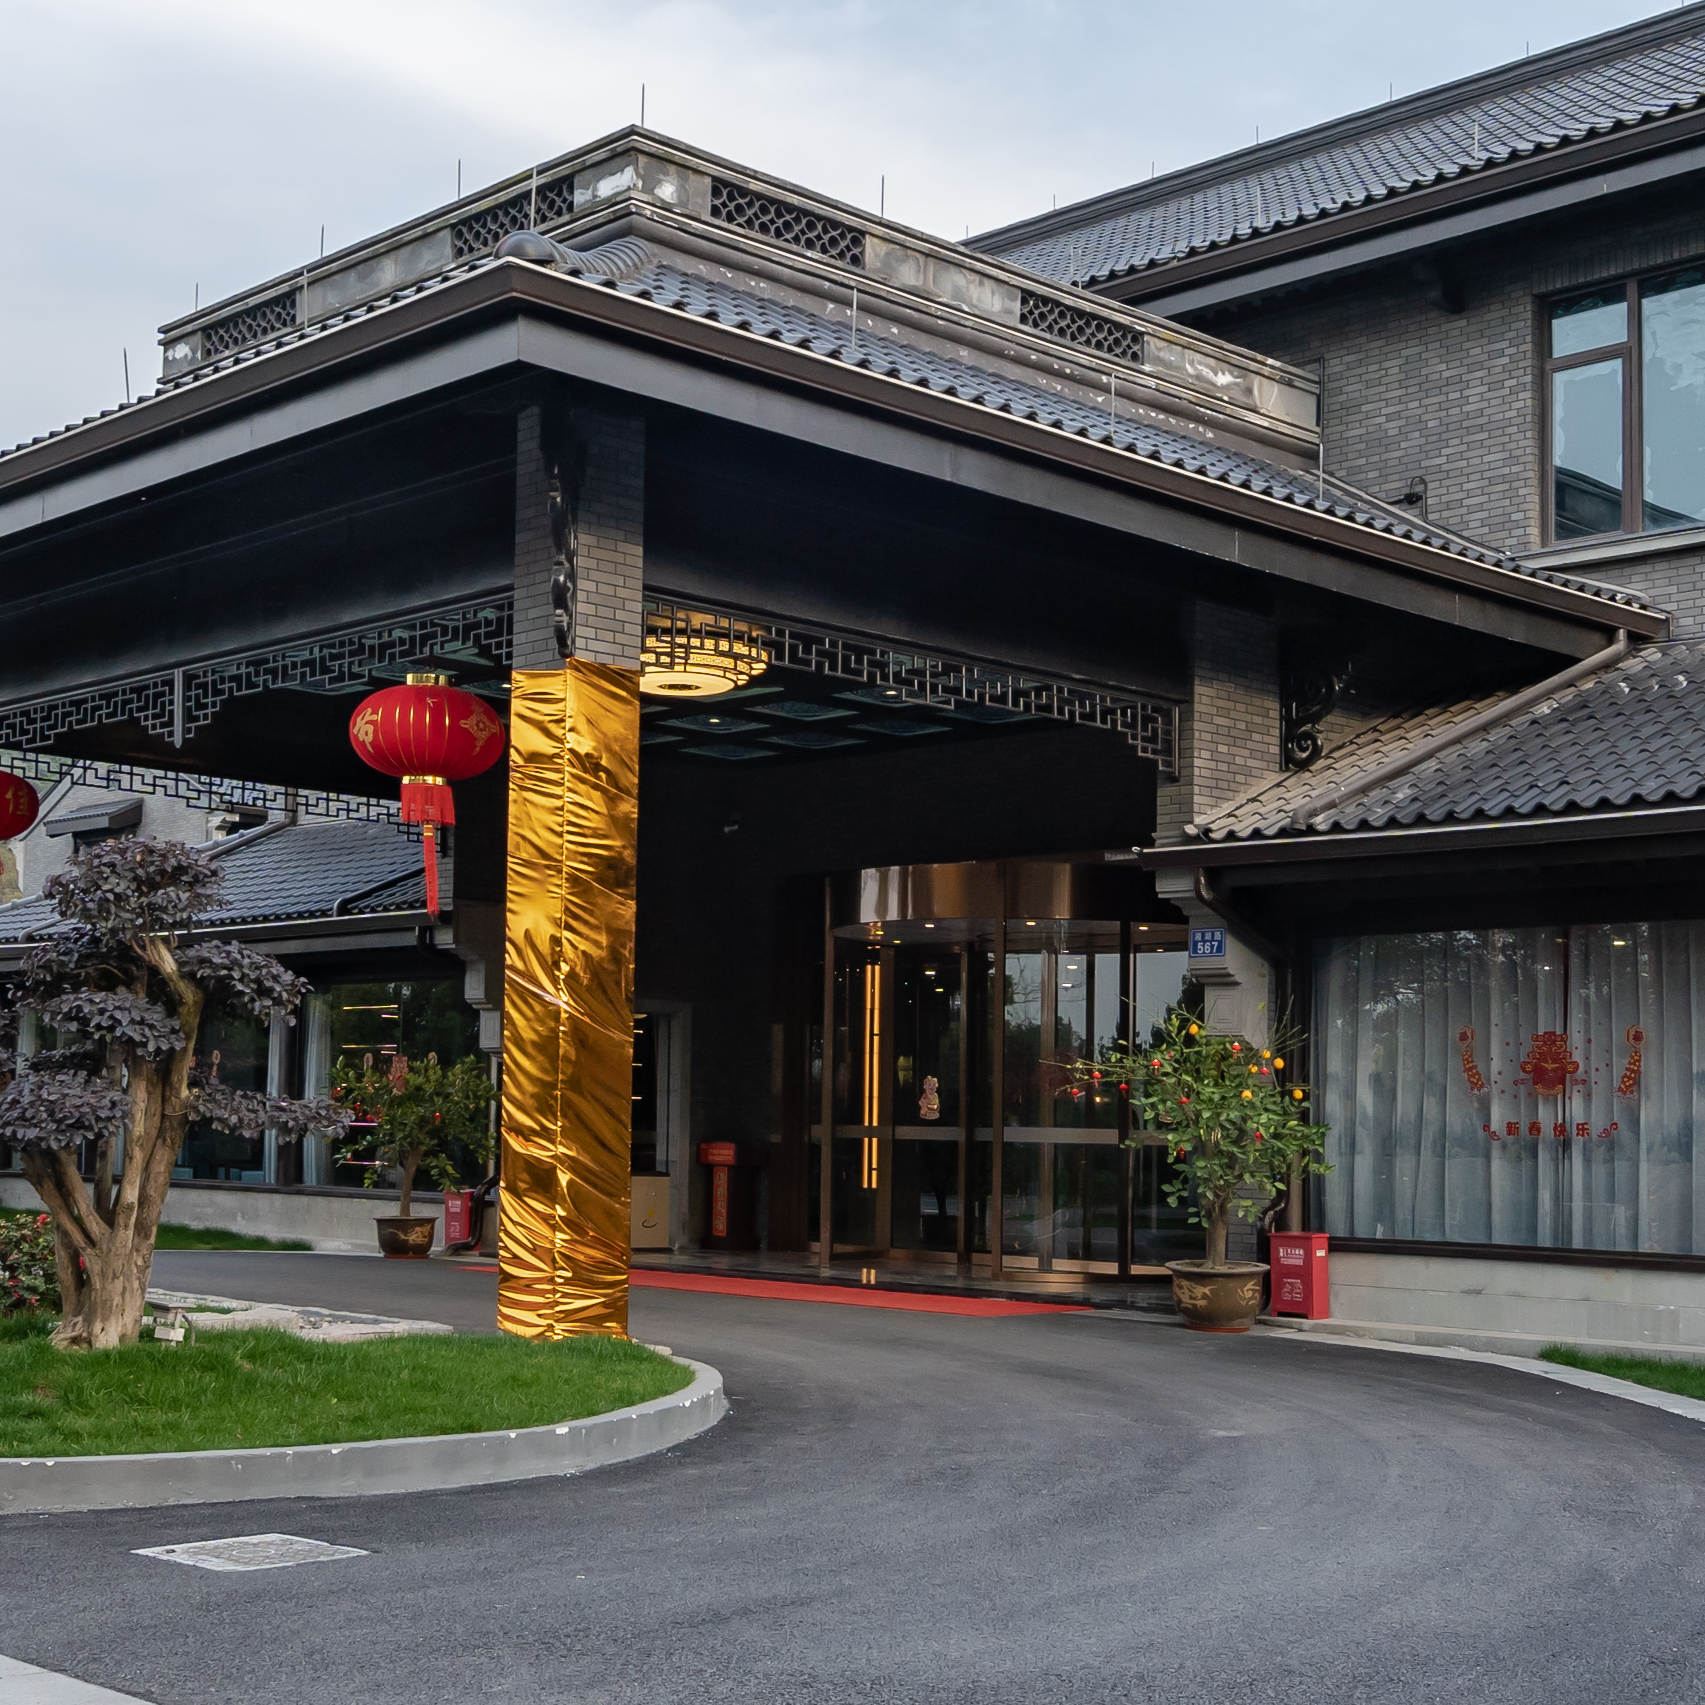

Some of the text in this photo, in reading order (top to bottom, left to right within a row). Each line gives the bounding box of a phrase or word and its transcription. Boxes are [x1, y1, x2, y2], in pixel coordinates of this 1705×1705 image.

[1197, 941, 1219, 954] 567
[1505, 1121, 1591, 1139] 新春快乐
